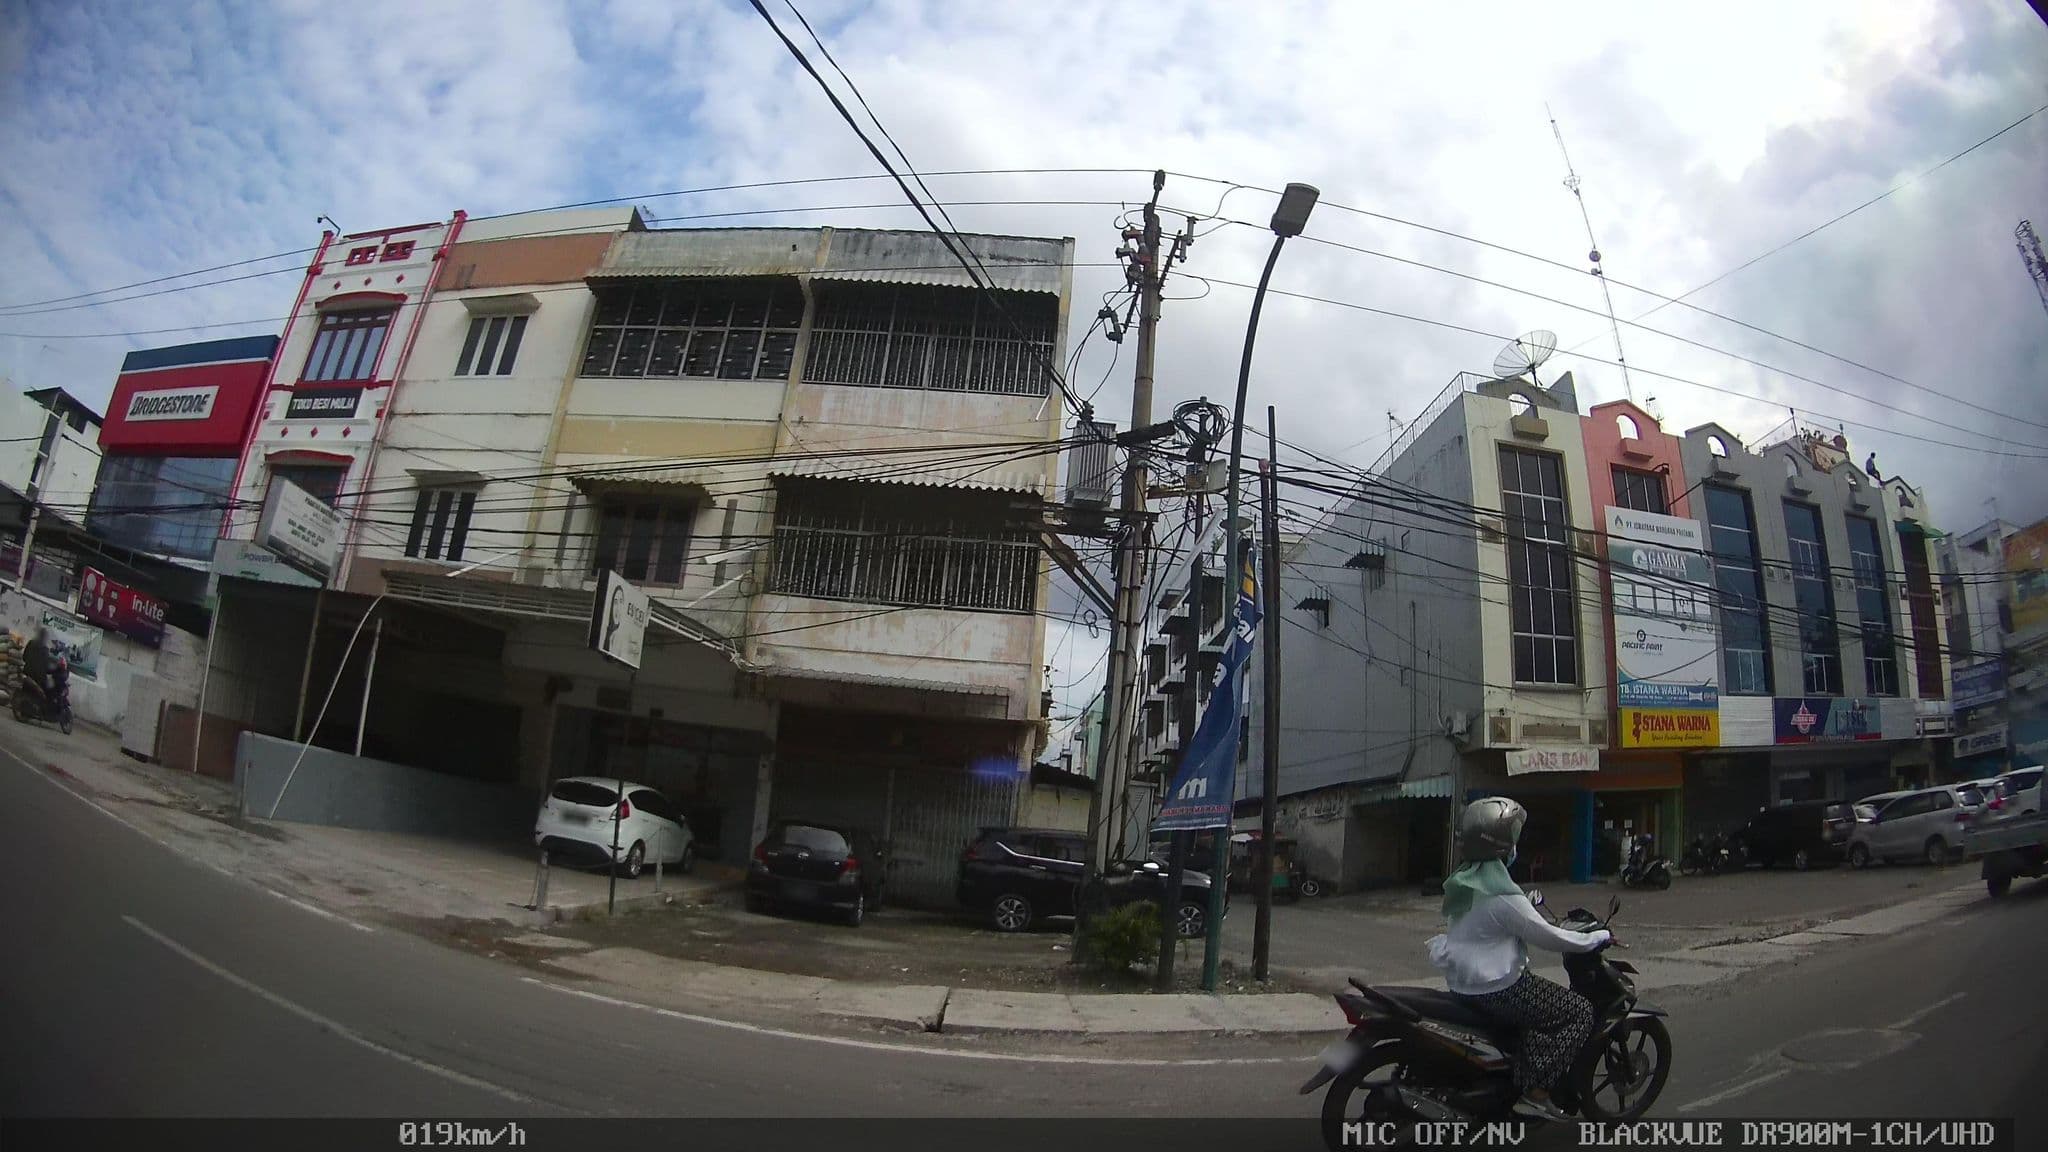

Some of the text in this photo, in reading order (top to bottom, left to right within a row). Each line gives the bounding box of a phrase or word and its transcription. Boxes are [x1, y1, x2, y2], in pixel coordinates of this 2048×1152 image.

[129, 393, 211, 416] BRIDGESTONE
[1647, 551, 1686, 569] GAMMA
[1633, 684, 1660, 695] ISTANA
[1661, 686, 1688, 696] WARNA
[1677, 715, 1711, 731] WARNA
[1562, 752, 1589, 769] BAN
